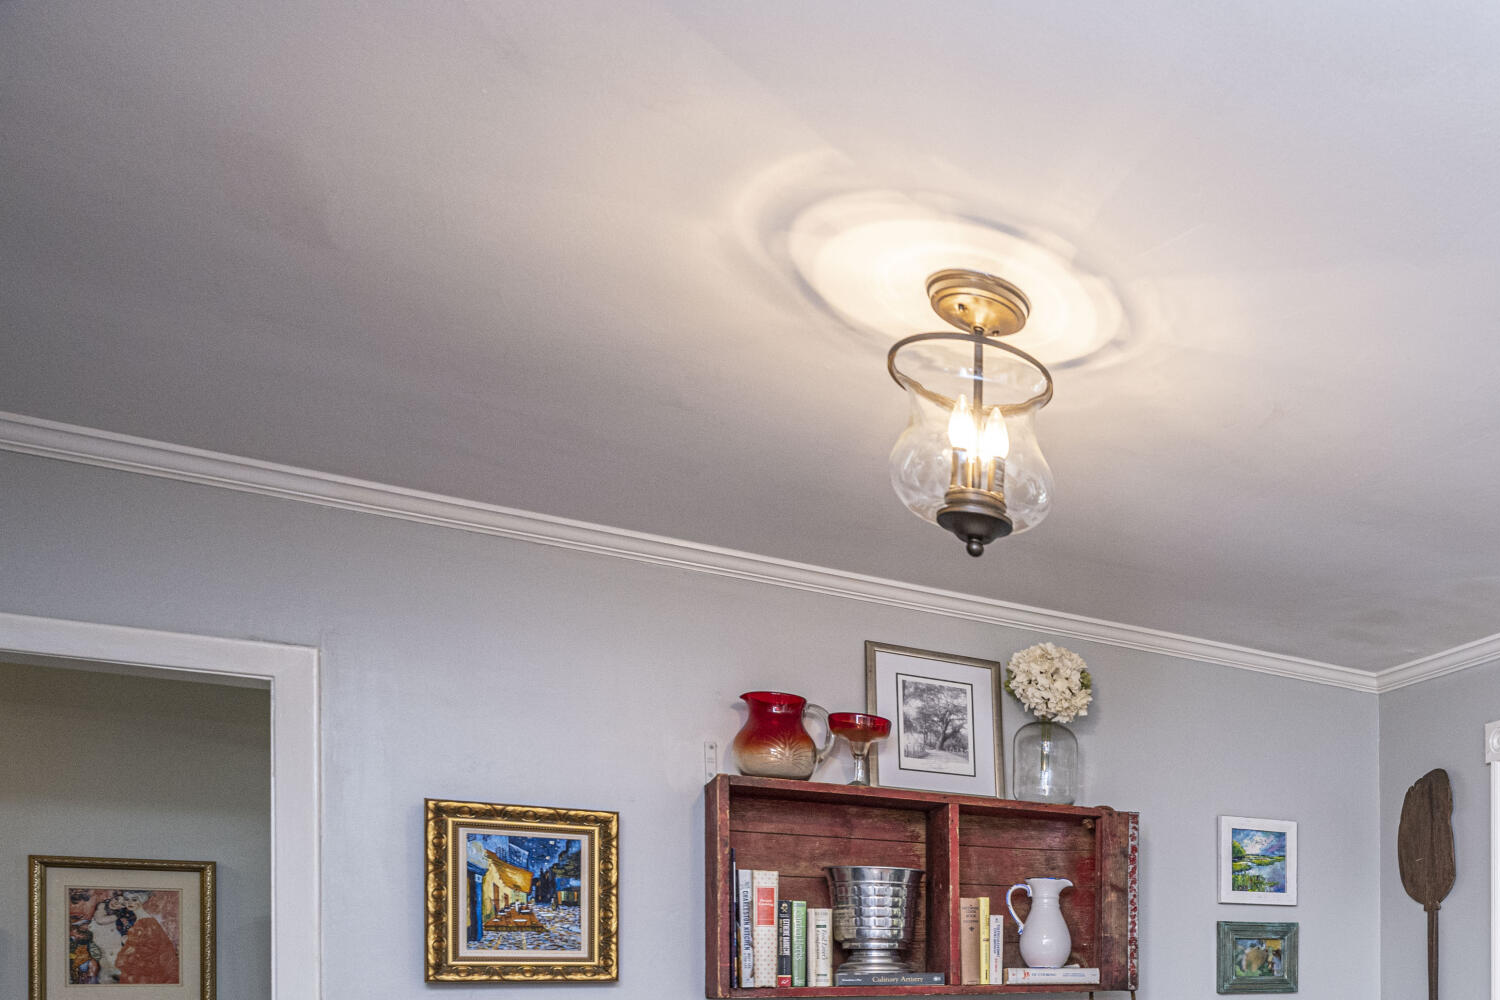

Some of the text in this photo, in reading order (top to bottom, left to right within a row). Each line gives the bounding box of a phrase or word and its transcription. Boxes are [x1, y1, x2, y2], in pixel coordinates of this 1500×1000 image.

[743, 927, 751, 951] KITCHEN
[871, 976, 899, 984] Culinary
[901, 975, 923, 983] Artistry
